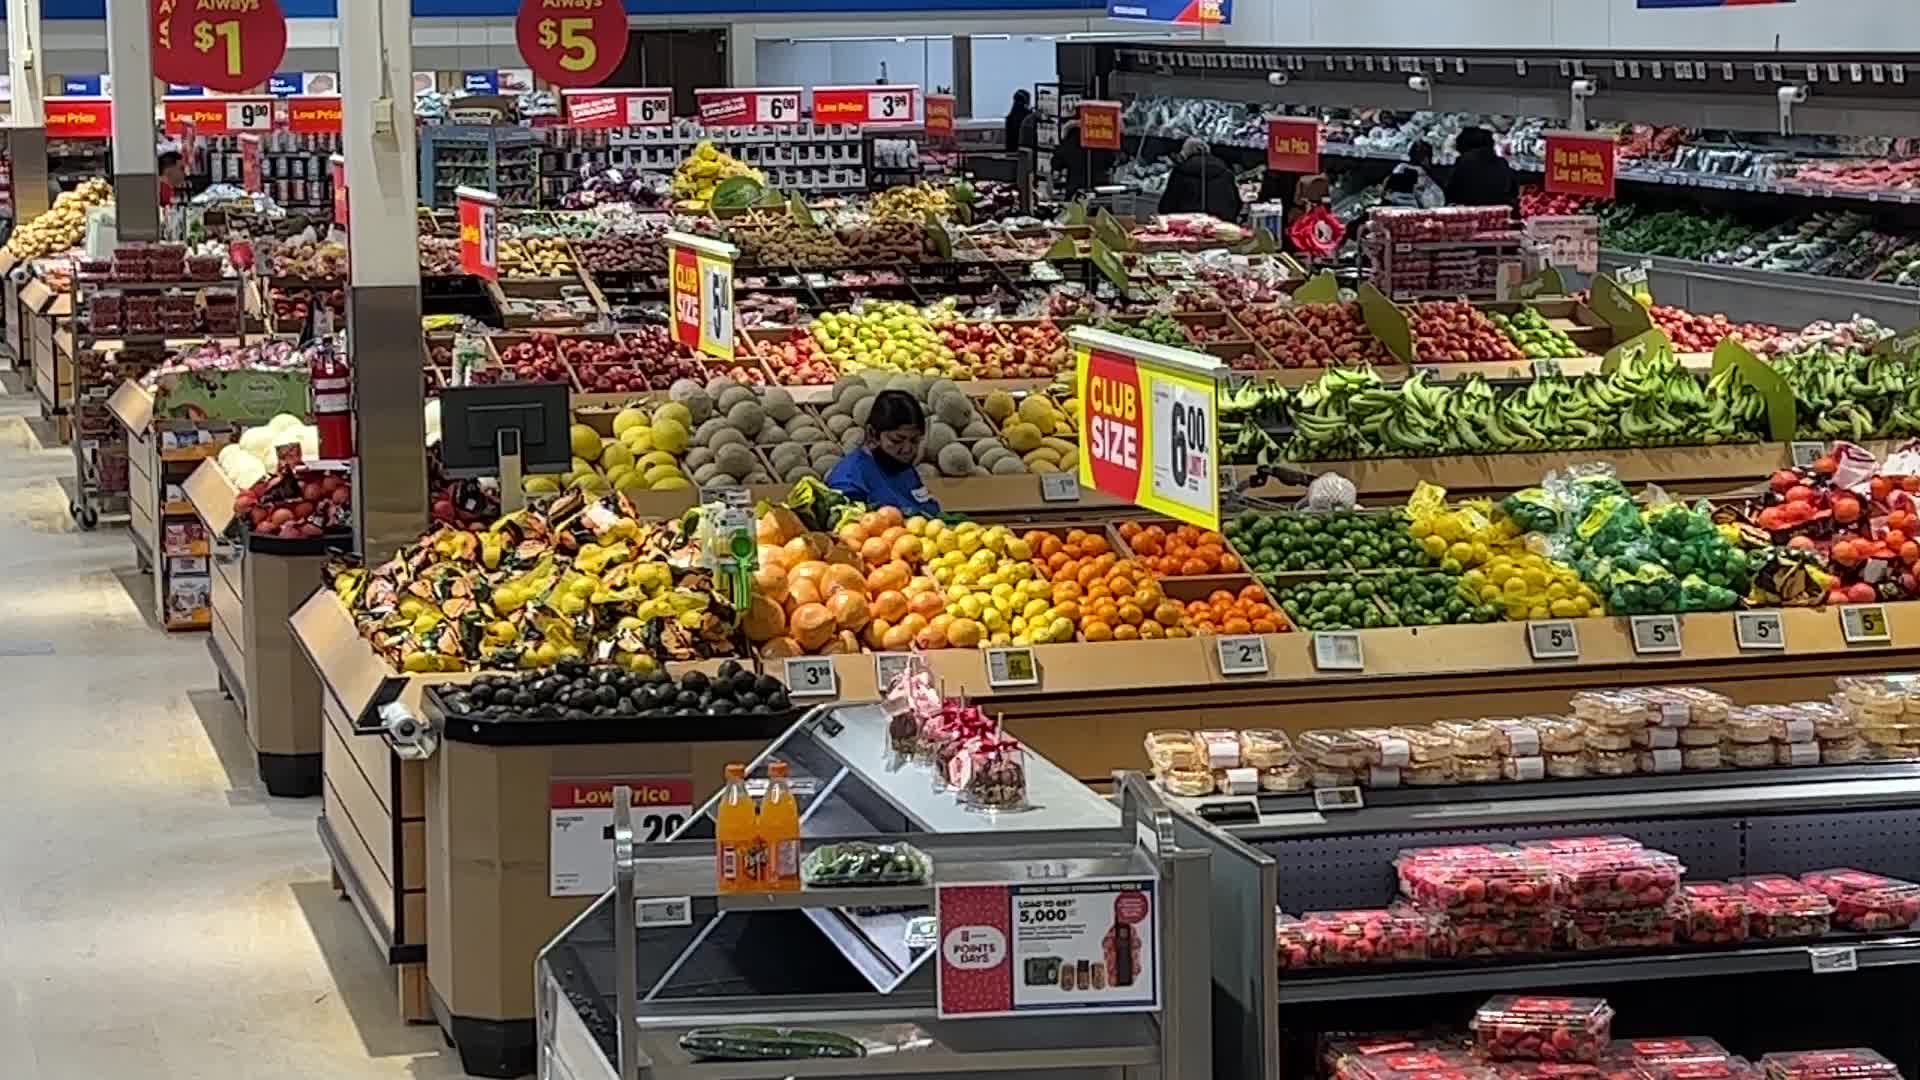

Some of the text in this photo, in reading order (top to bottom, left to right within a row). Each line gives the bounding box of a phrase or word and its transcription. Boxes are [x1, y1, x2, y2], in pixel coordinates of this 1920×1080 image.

[194, 20, 241, 75] $1
[538, 18, 597, 71] $5
[1091, 376, 1137, 421] CLUB
[1091, 415, 1138, 471] SIZE
[632, 786, 671, 803] rice
[1019, 908, 1067, 925] 5,000
